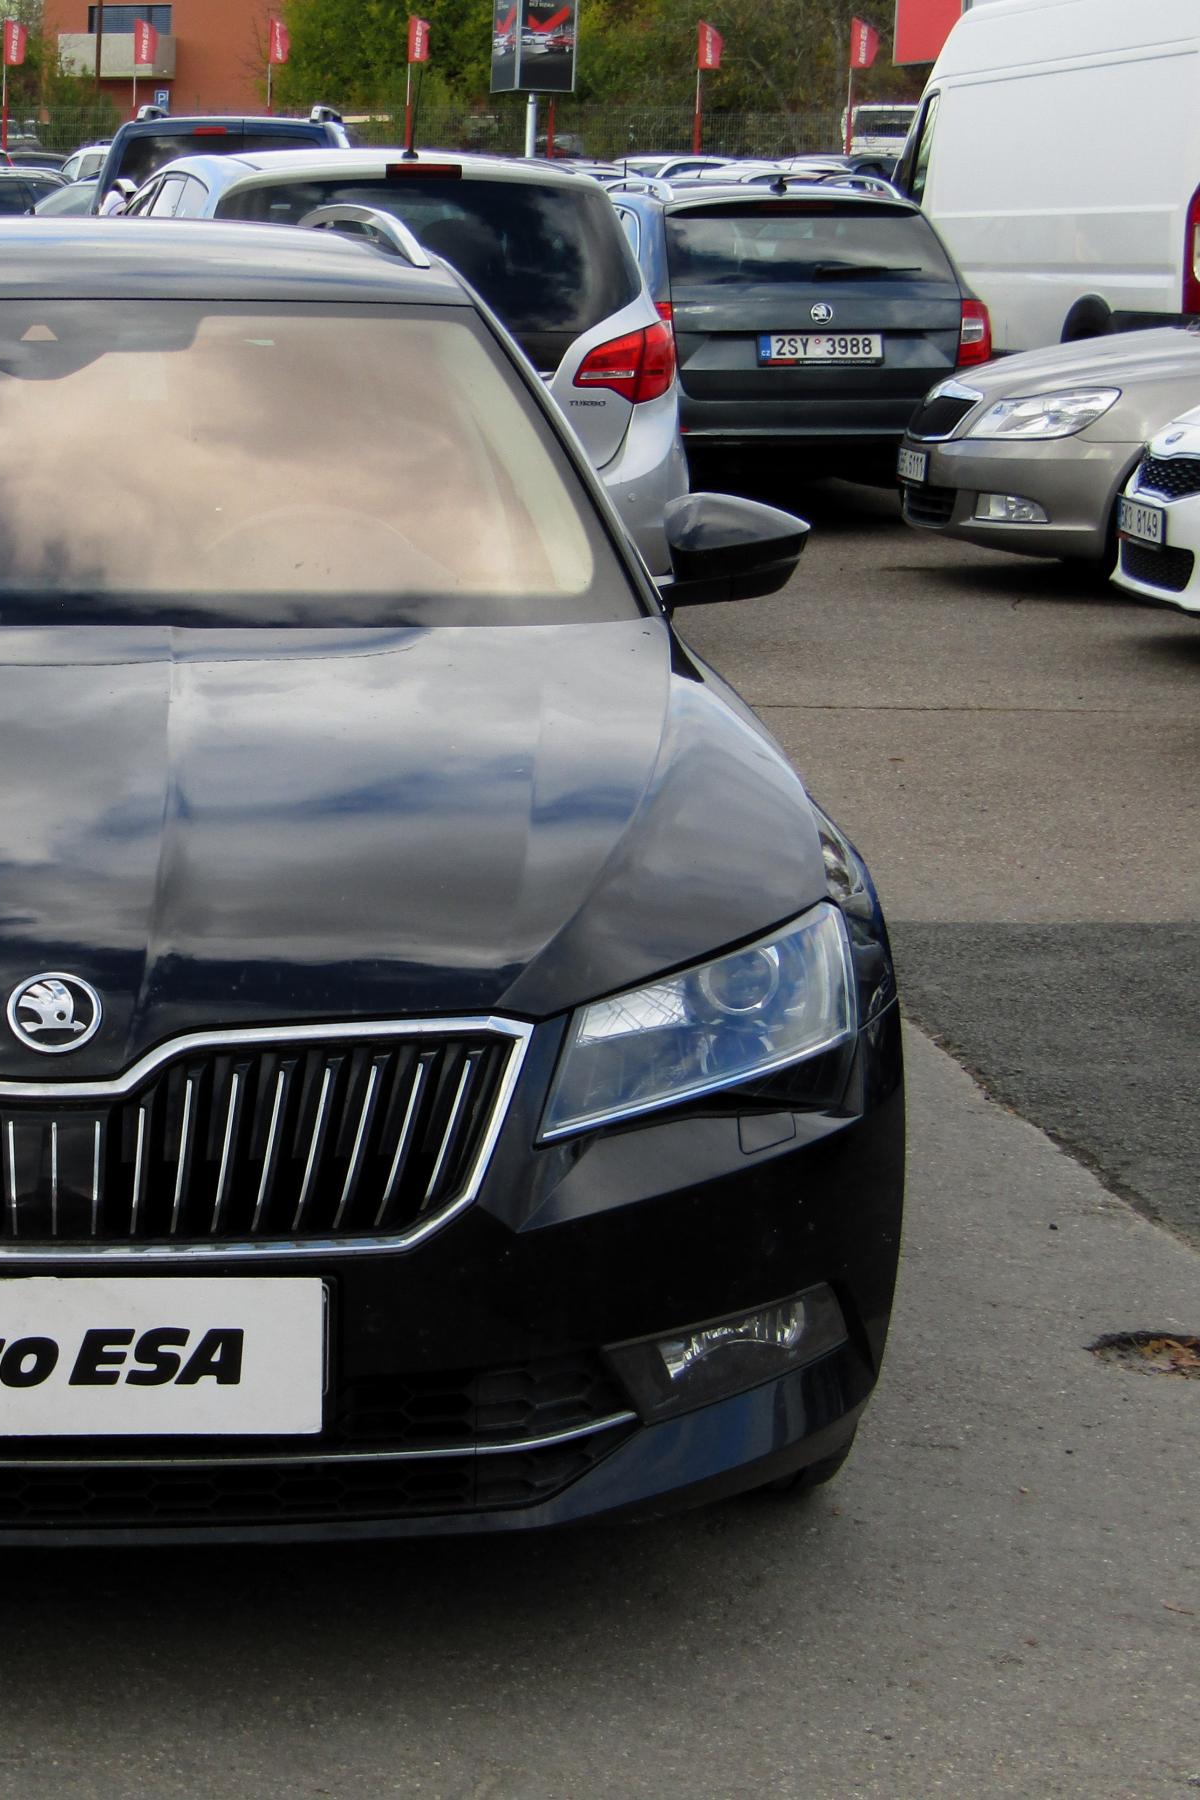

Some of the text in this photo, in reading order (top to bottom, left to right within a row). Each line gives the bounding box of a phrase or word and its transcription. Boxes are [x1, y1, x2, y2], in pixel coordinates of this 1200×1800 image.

[158, 93, 166, 104] P
[775, 337, 872, 355] 2SY 3988
[1137, 509, 1158, 538] 8149
[68, 1327, 244, 1386] ESA
